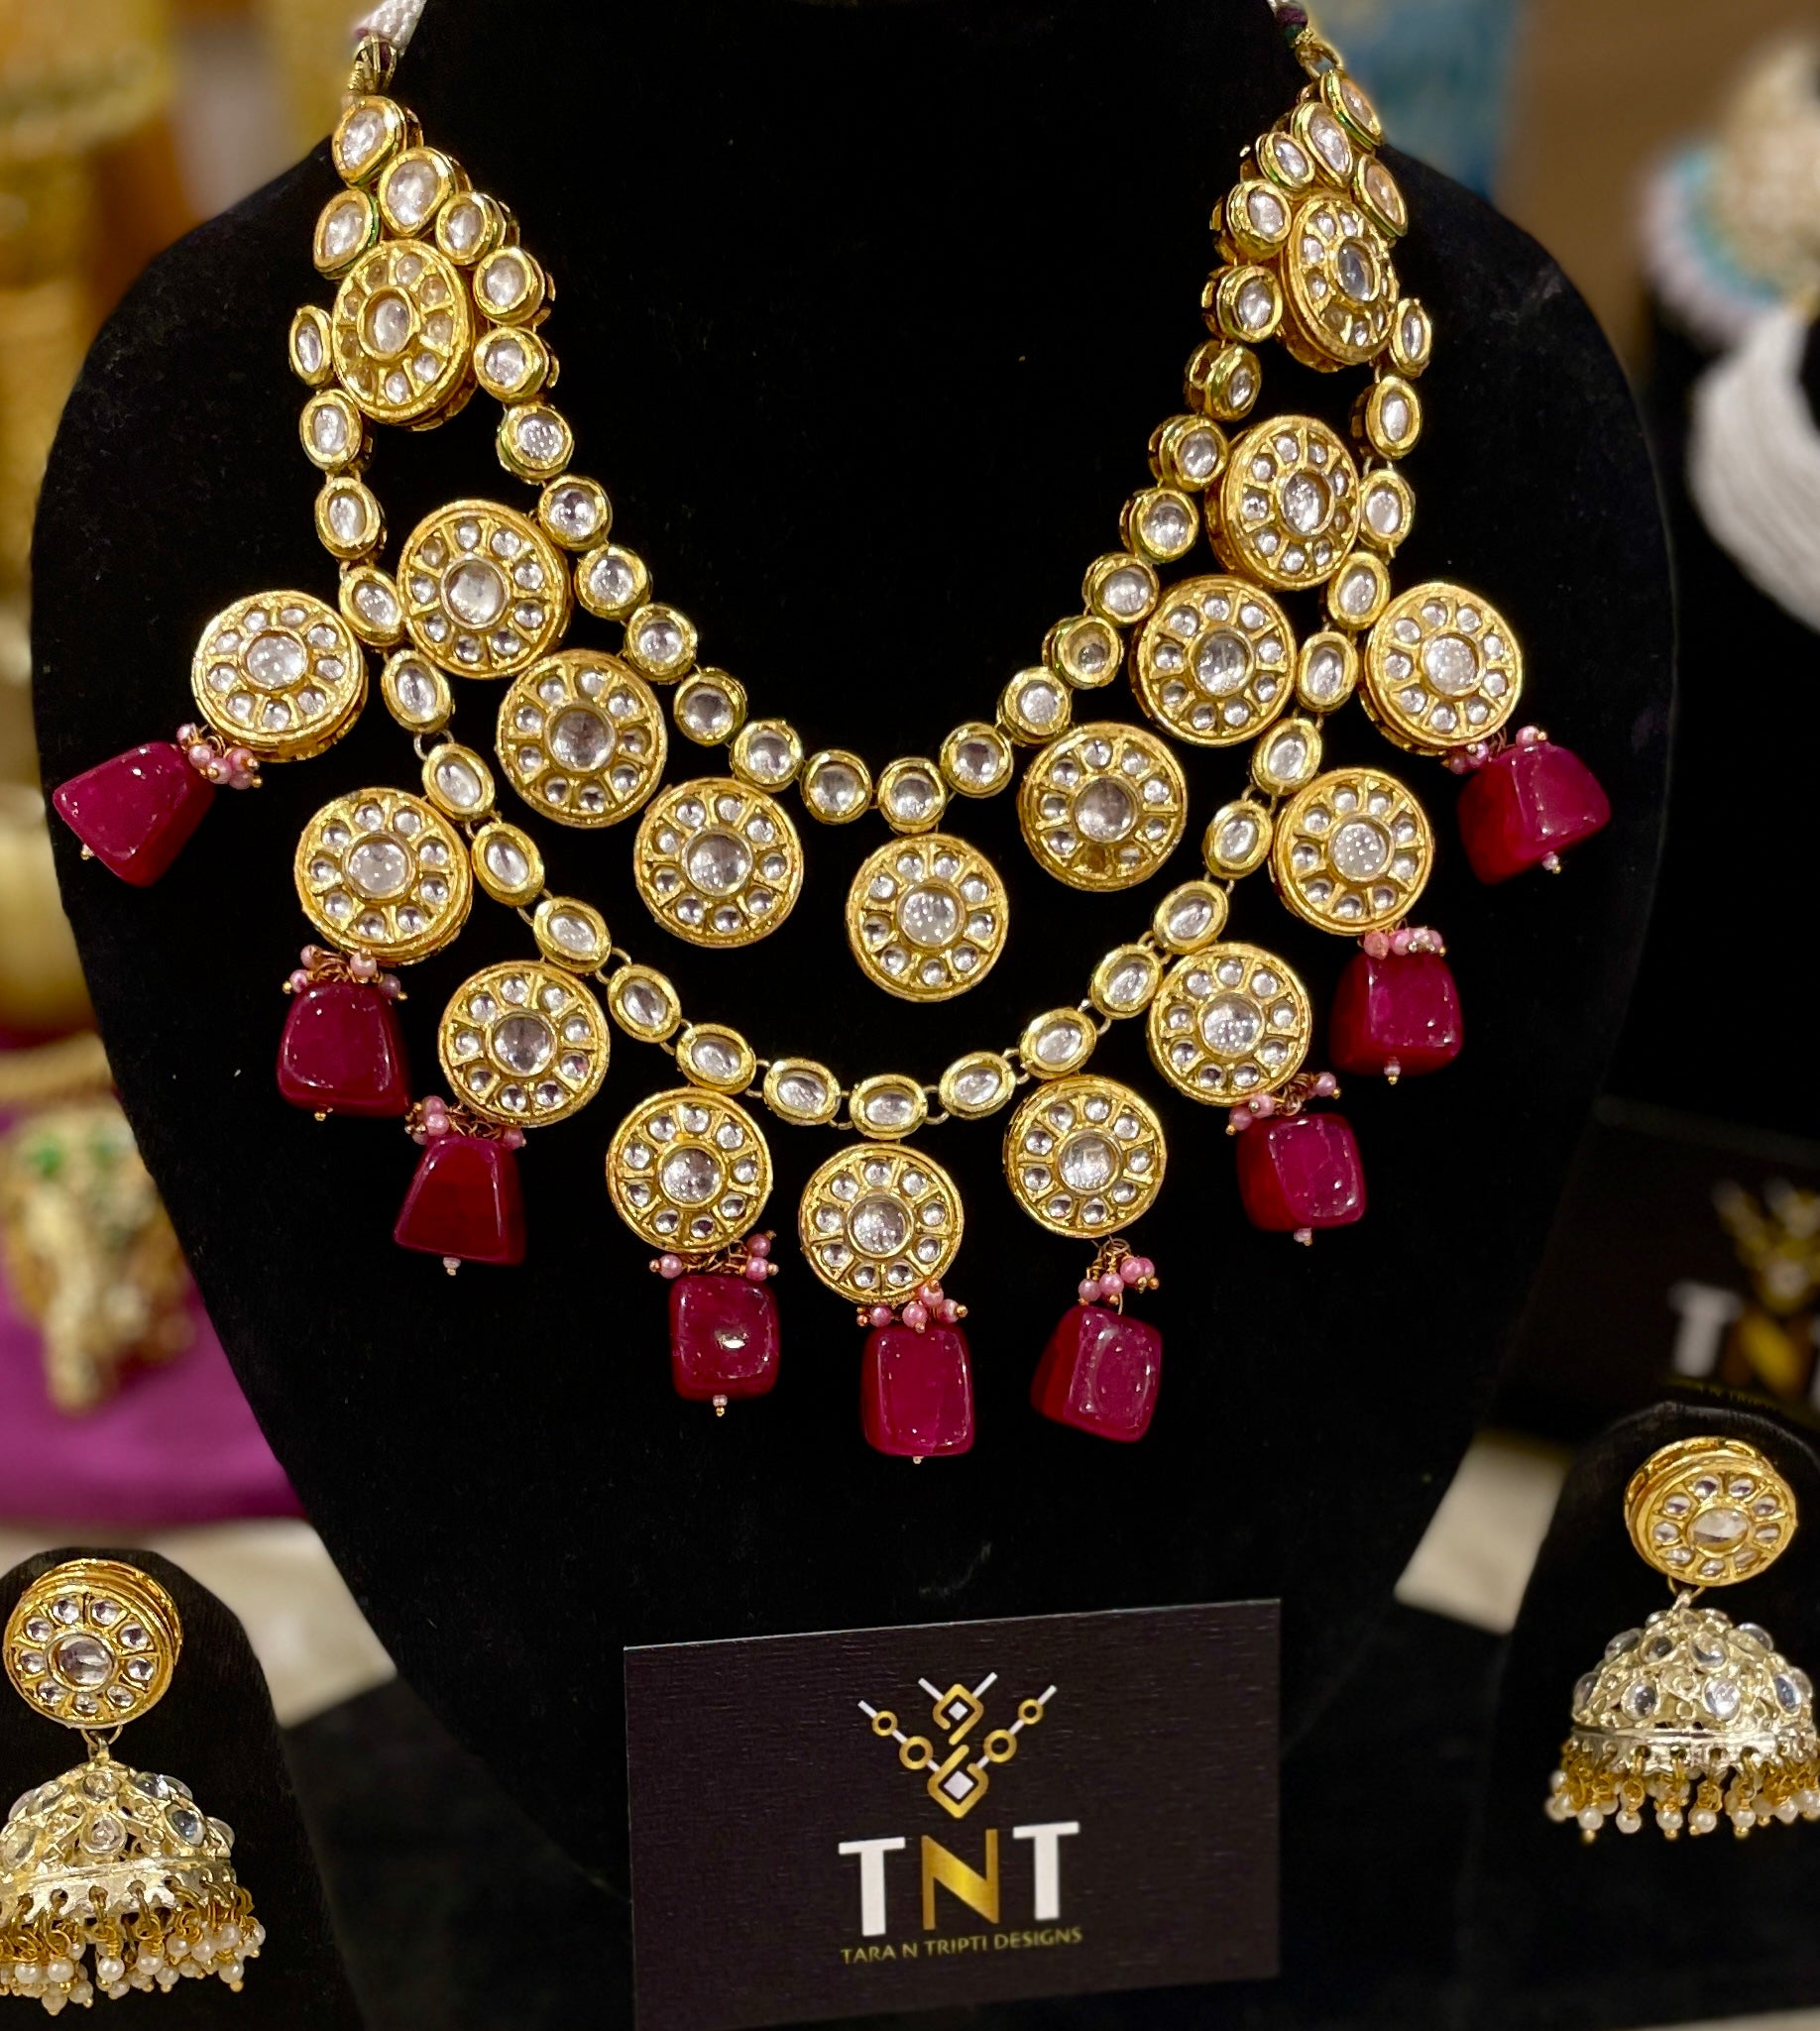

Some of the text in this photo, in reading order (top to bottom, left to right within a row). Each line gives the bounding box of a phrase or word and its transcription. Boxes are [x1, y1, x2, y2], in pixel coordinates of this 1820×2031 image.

[1667, 1280, 1820, 1412] TN
[839, 1821, 1081, 1937] TNT
[840, 1926, 1083, 1965] TARA N TRIPTI DESIGNS
